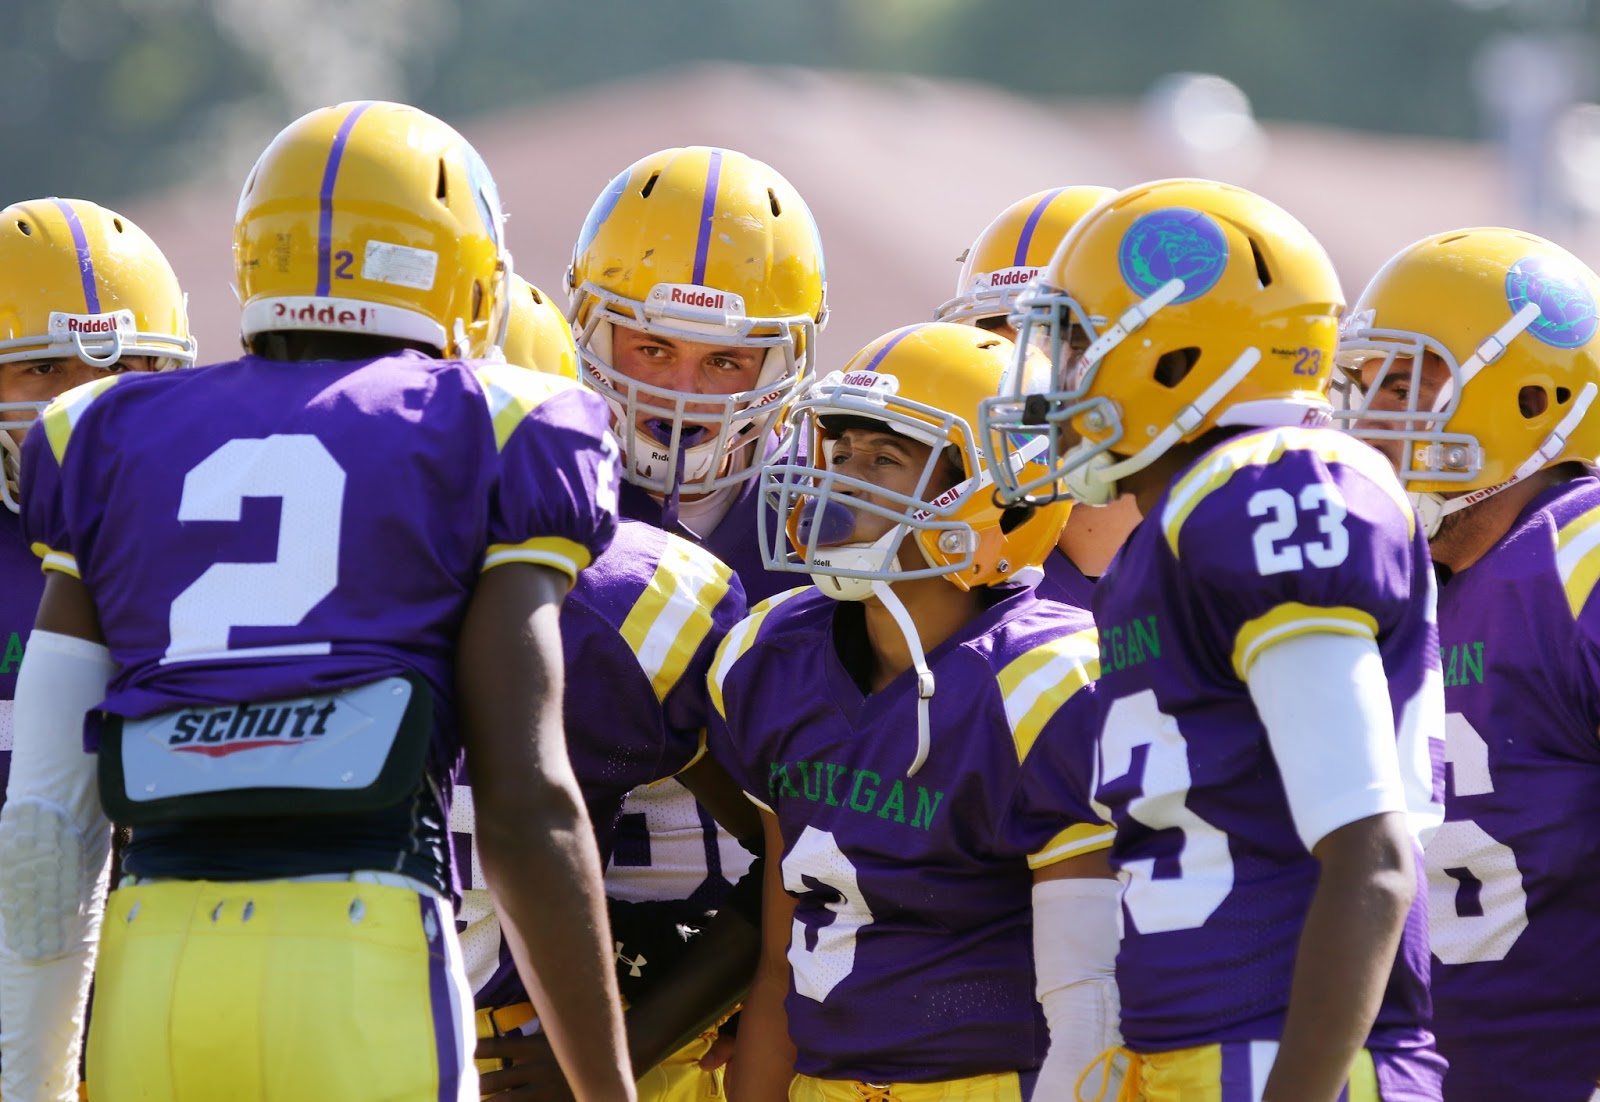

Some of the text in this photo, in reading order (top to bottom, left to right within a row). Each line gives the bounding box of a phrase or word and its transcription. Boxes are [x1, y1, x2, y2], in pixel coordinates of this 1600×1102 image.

[335, 251, 354, 279] 2
[991, 270, 1038, 286] Riddell
[671, 288, 724, 308] Riddell
[68, 316, 117, 333] Riddell
[272, 303, 376, 329] Riddel
[1293, 347, 1321, 376] 23
[843, 373, 879, 387] Riddel
[1247, 482, 1350, 576] 23
[159, 434, 347, 665] 2
[169, 700, 336, 745] schutt
